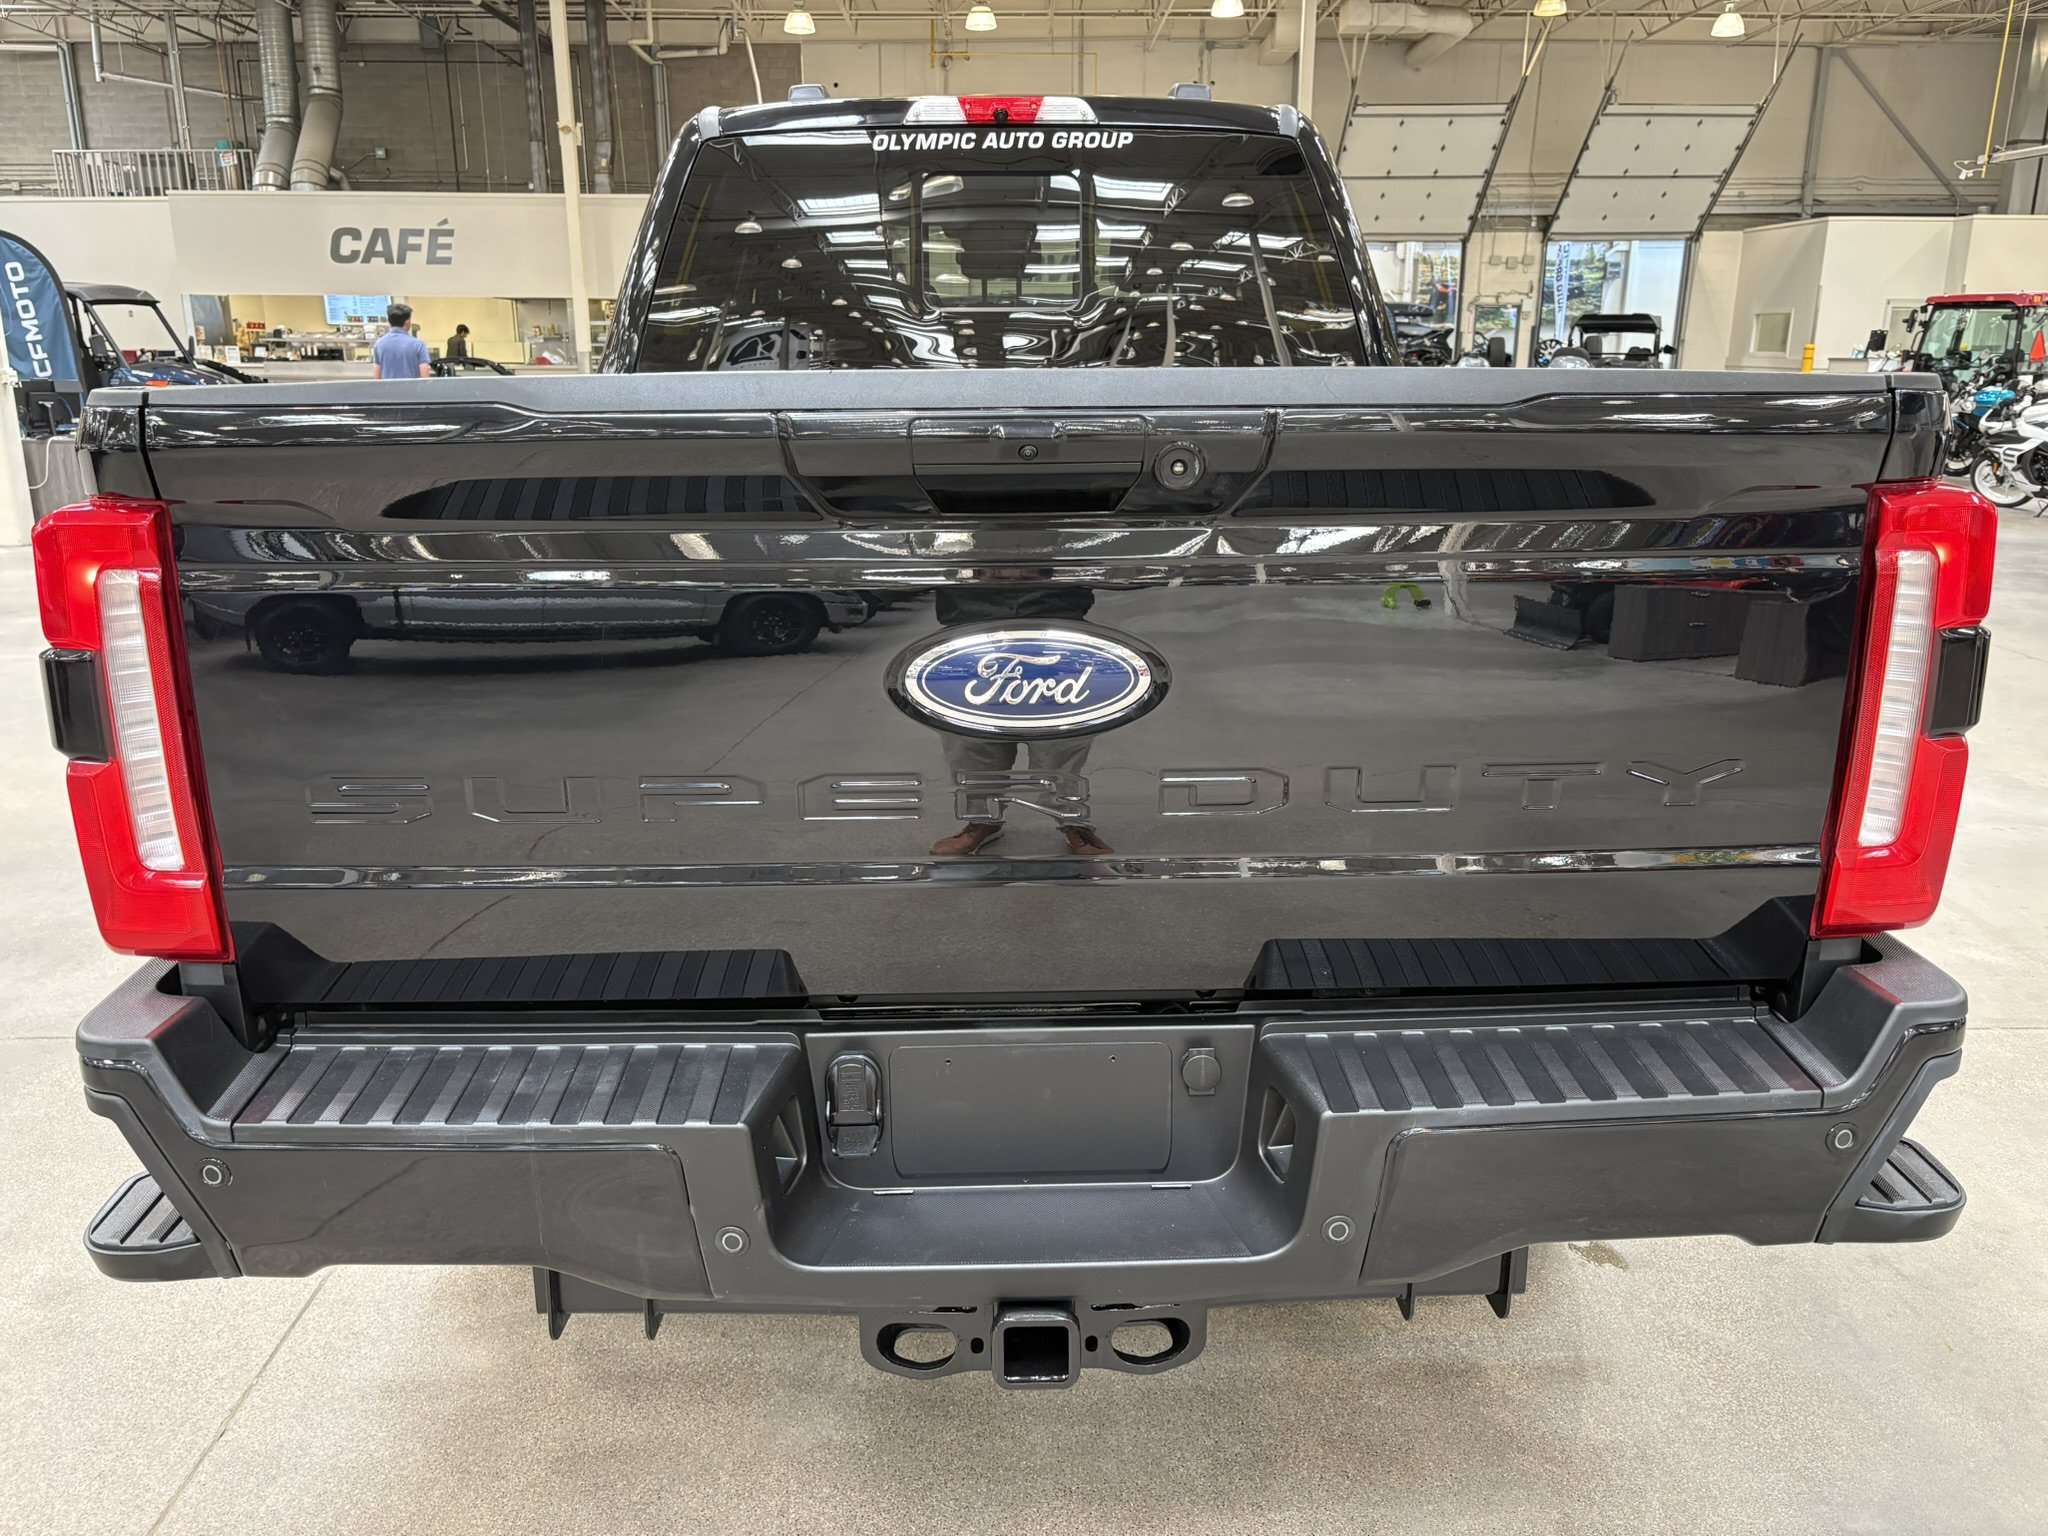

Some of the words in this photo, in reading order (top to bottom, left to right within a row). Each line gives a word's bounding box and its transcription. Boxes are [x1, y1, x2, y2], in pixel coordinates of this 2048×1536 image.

[872, 132, 976, 151] OLYMPIC
[982, 131, 1045, 150] AUTO
[1051, 131, 1134, 149] GROUP
[330, 218, 455, 265] CAFÉ
[5, 261, 52, 378] CFMOTO
[964, 652, 1093, 705] Ford
[304, 770, 1091, 825] SUPER
[1160, 758, 1744, 816] DUTY
